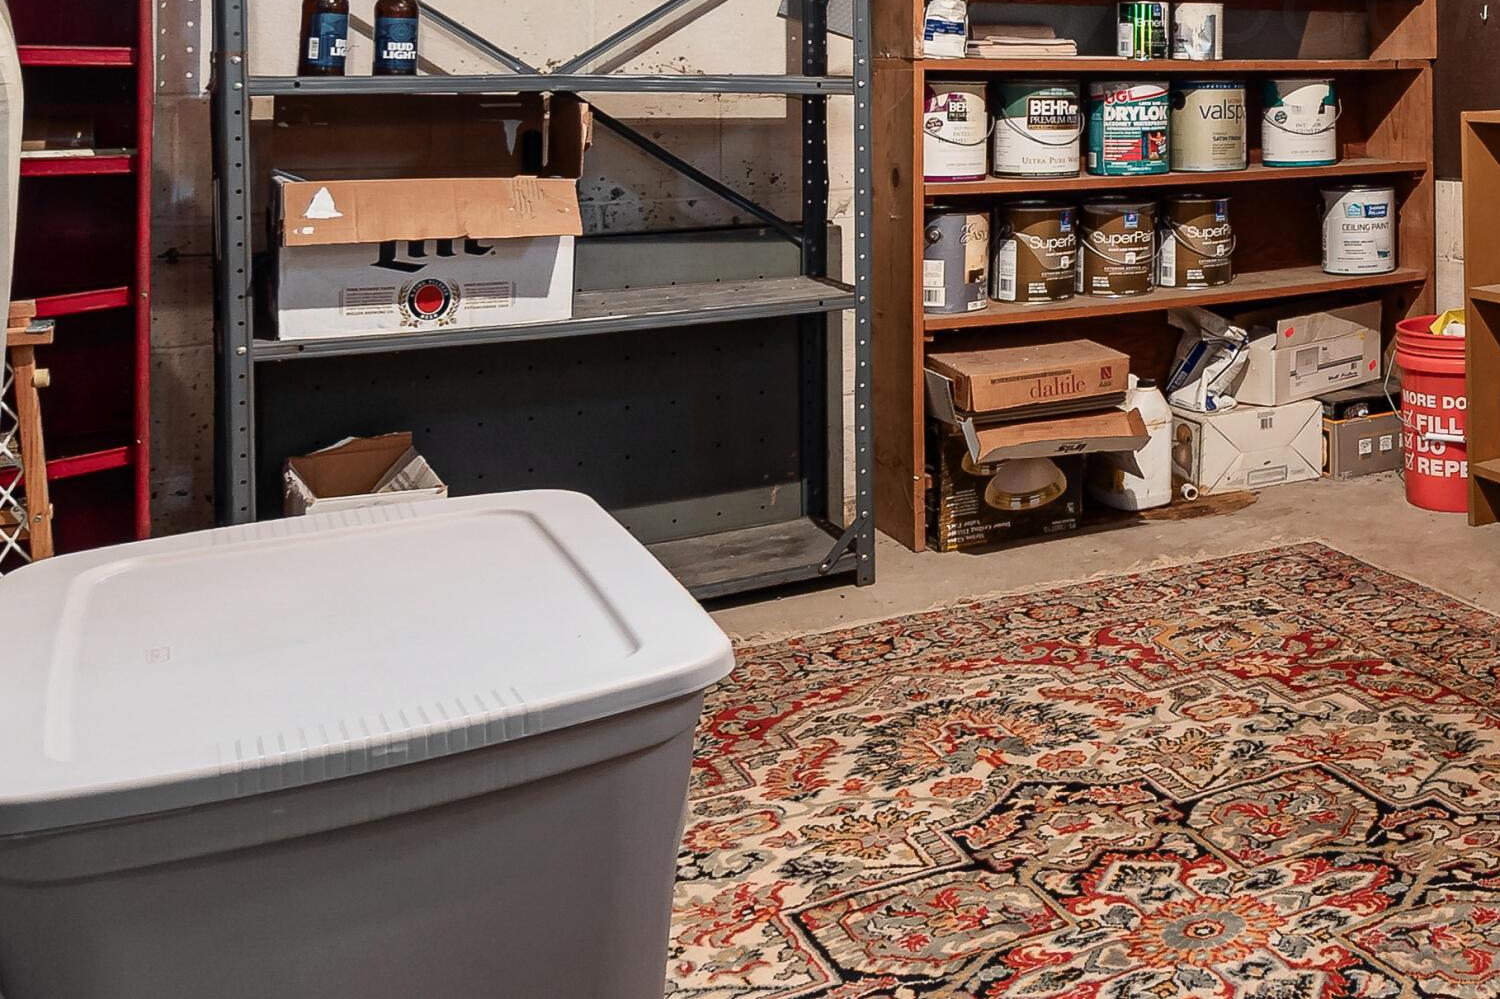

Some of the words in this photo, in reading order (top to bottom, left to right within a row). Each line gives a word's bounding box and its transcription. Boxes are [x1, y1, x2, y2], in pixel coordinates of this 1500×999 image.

[330, 47, 347, 56] LIG
[388, 42, 414, 51] BUD
[383, 51, 416, 59] LIGHT
[950, 101, 968, 113] BEH
[1031, 100, 1069, 116] BEHR
[1105, 105, 1169, 121] DRYLOK
[1199, 99, 1246, 124] valsp
[1030, 116, 1066, 124] PREMIUM
[1342, 223, 1370, 231] CEILING
[1371, 222, 1389, 230] PAINT
[1030, 374, 1086, 400] daltile
[1402, 388, 1436, 409] MORE
[1416, 413, 1464, 435] FILL
[1417, 435, 1446, 455] DO
[1417, 456, 1468, 478] REPE
